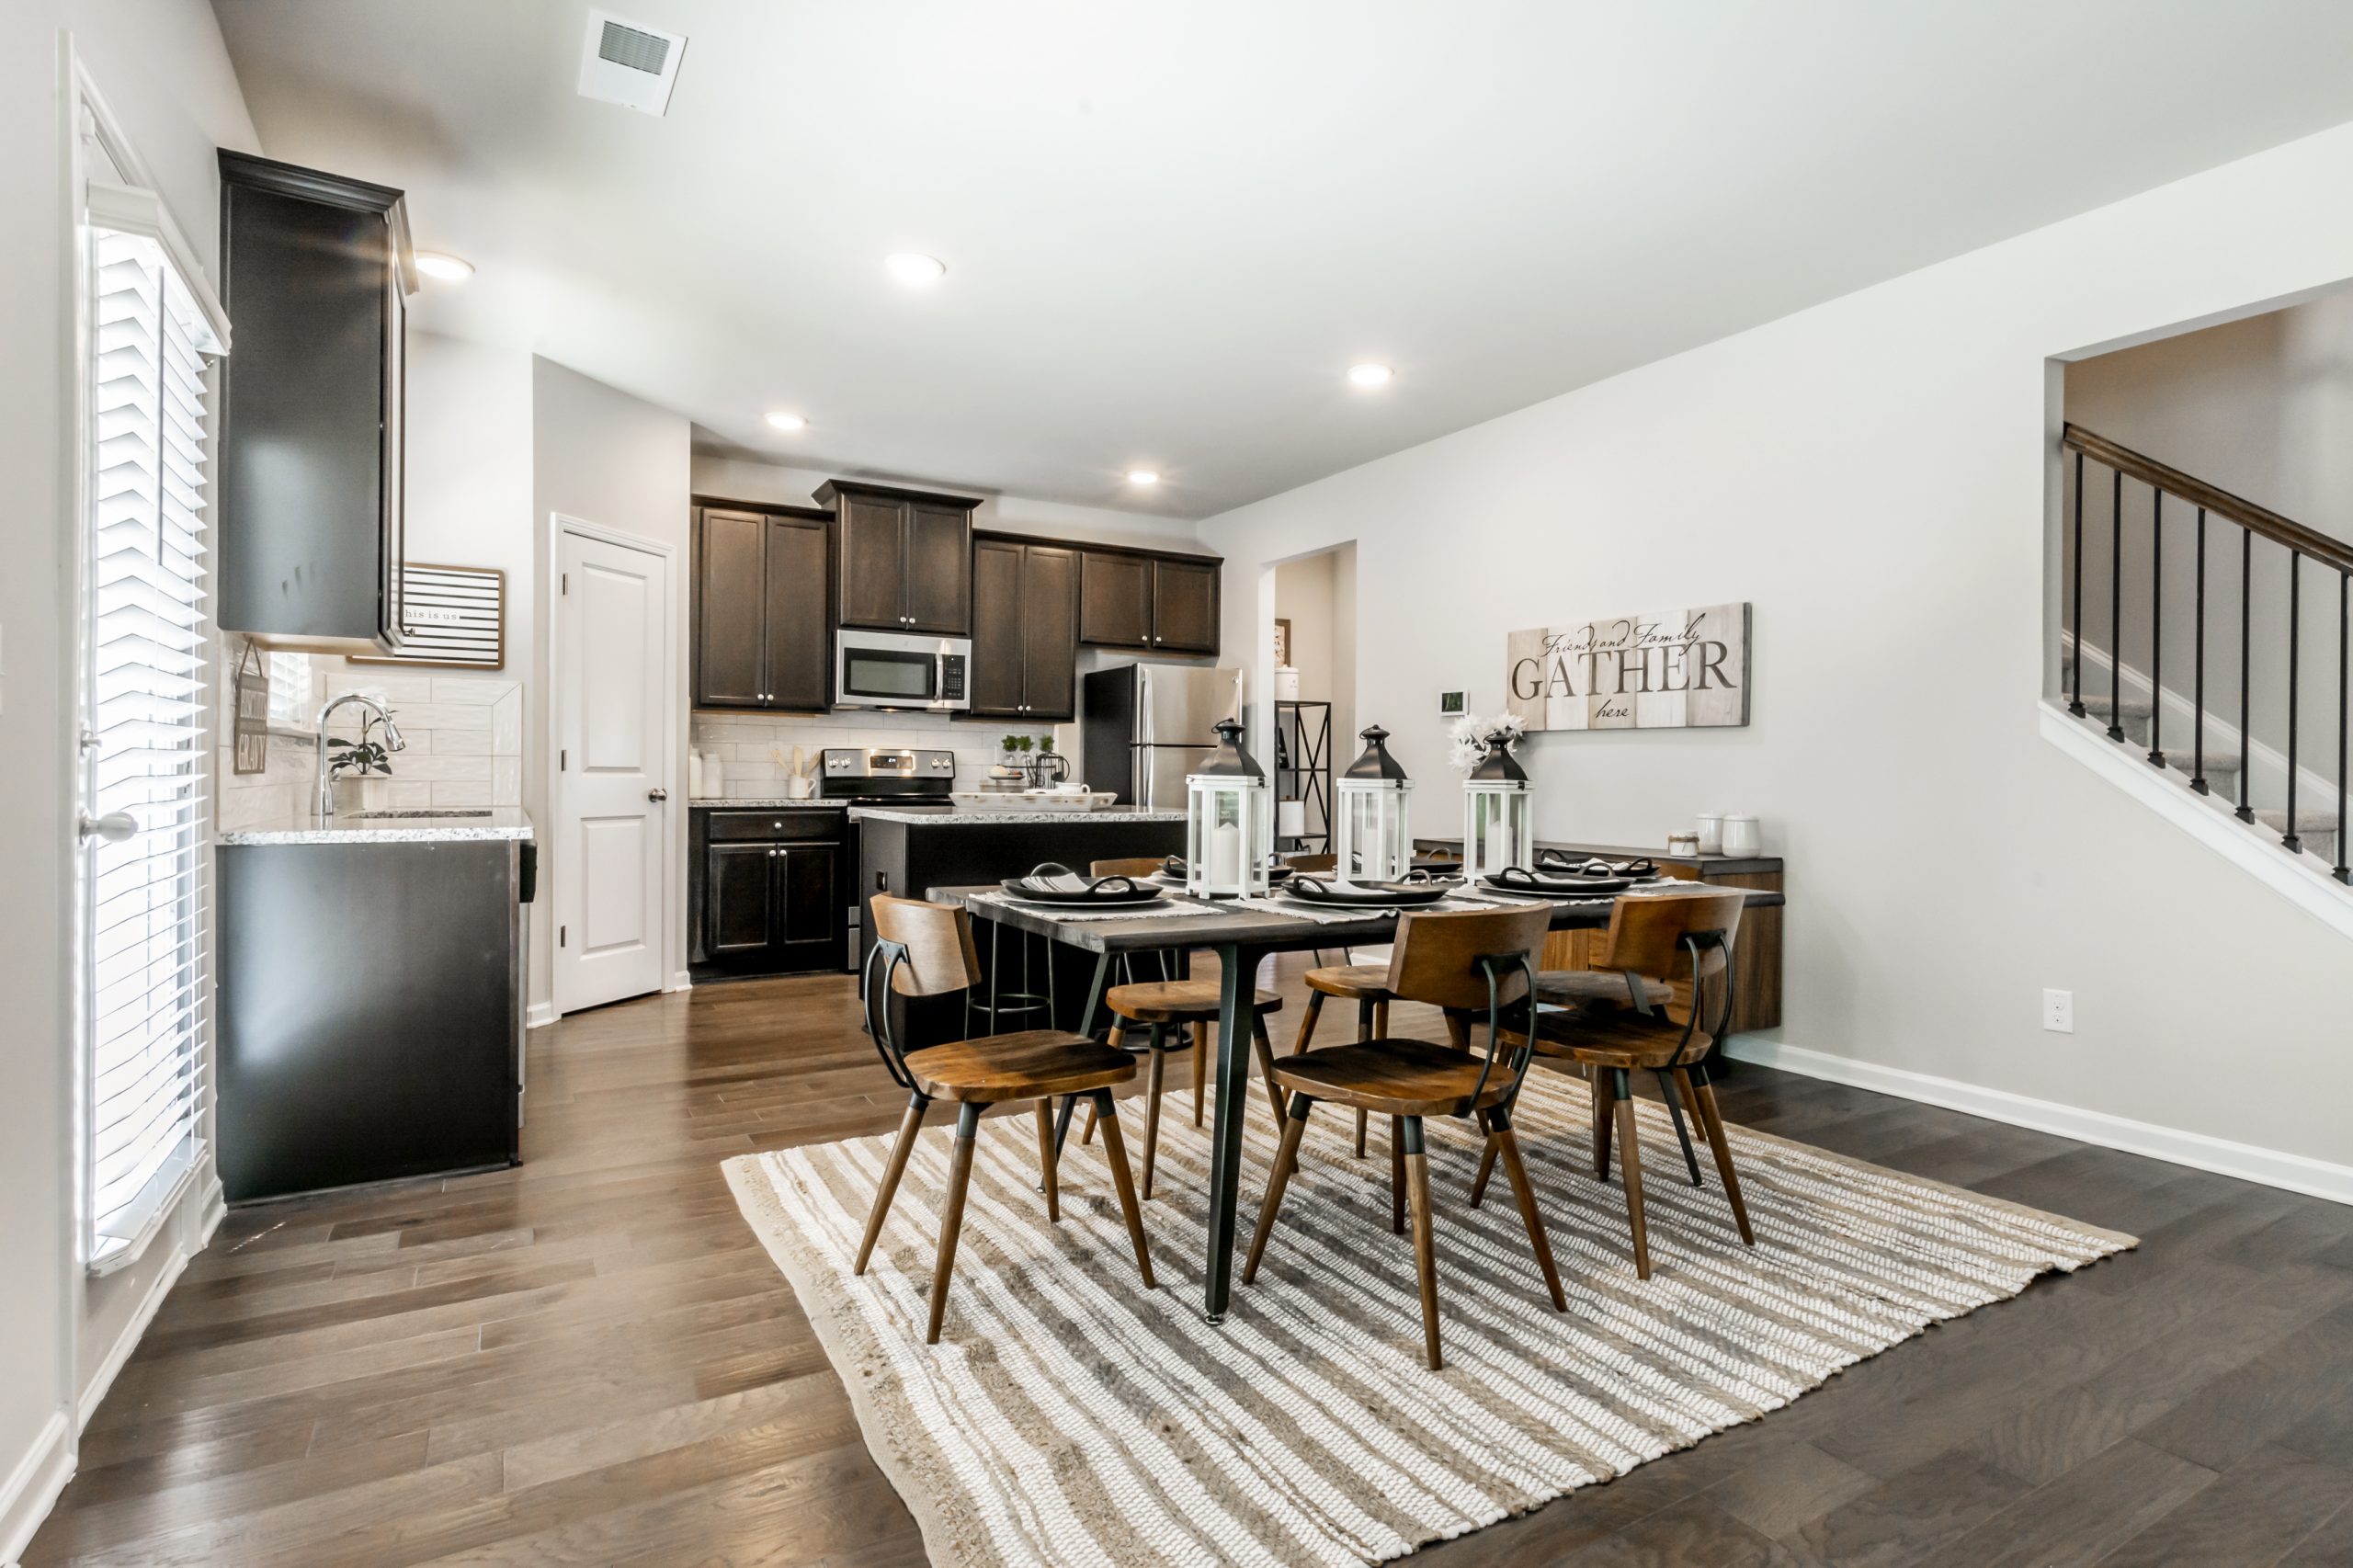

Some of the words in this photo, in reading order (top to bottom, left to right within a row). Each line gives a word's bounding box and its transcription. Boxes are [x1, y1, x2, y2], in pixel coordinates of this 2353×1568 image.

[404, 609, 424, 619] his
[427, 610, 438, 619] is
[1600, 619, 1631, 649] and
[1629, 612, 1707, 656] Family
[1511, 641, 1738, 700] GATHER
[1595, 699, 1630, 719] here
[238, 733, 266, 770] GRAVY
